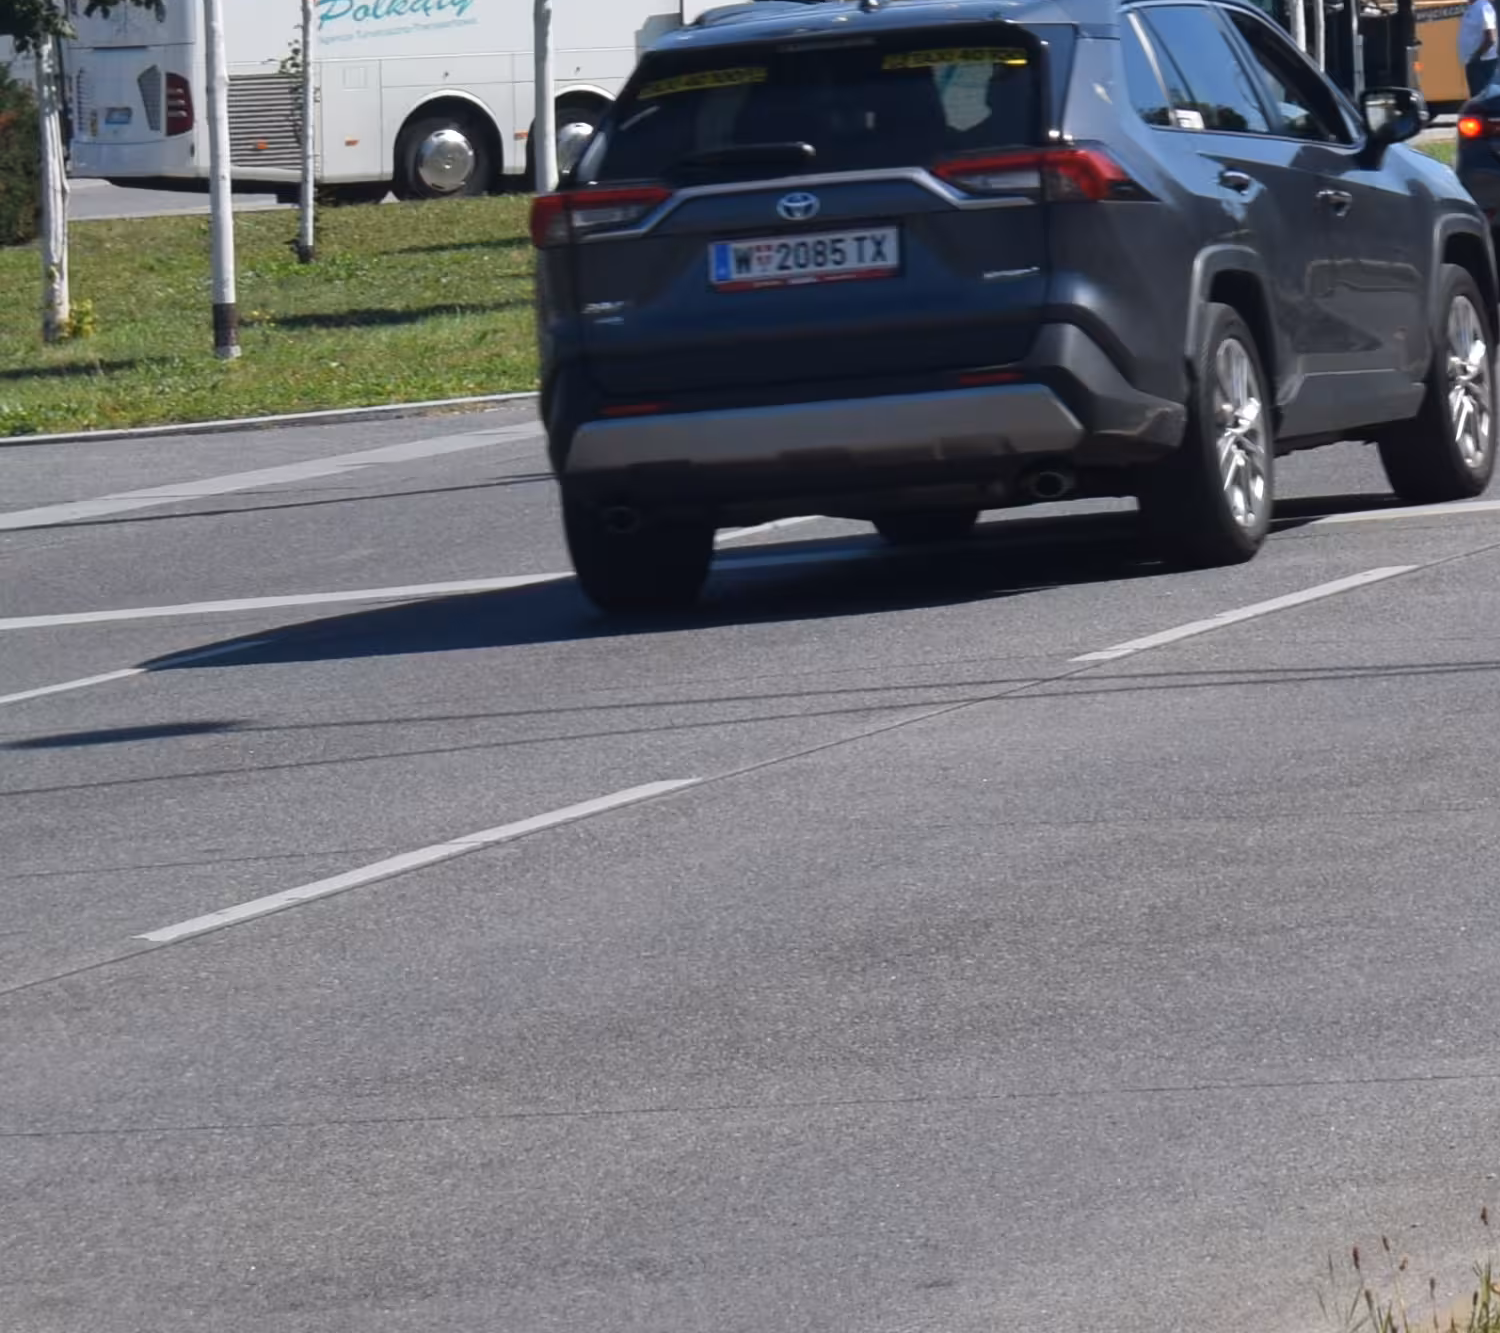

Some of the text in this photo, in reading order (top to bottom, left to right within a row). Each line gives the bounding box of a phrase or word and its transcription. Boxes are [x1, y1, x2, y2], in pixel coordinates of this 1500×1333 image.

[735, 234, 888, 274] W 2085 TX
